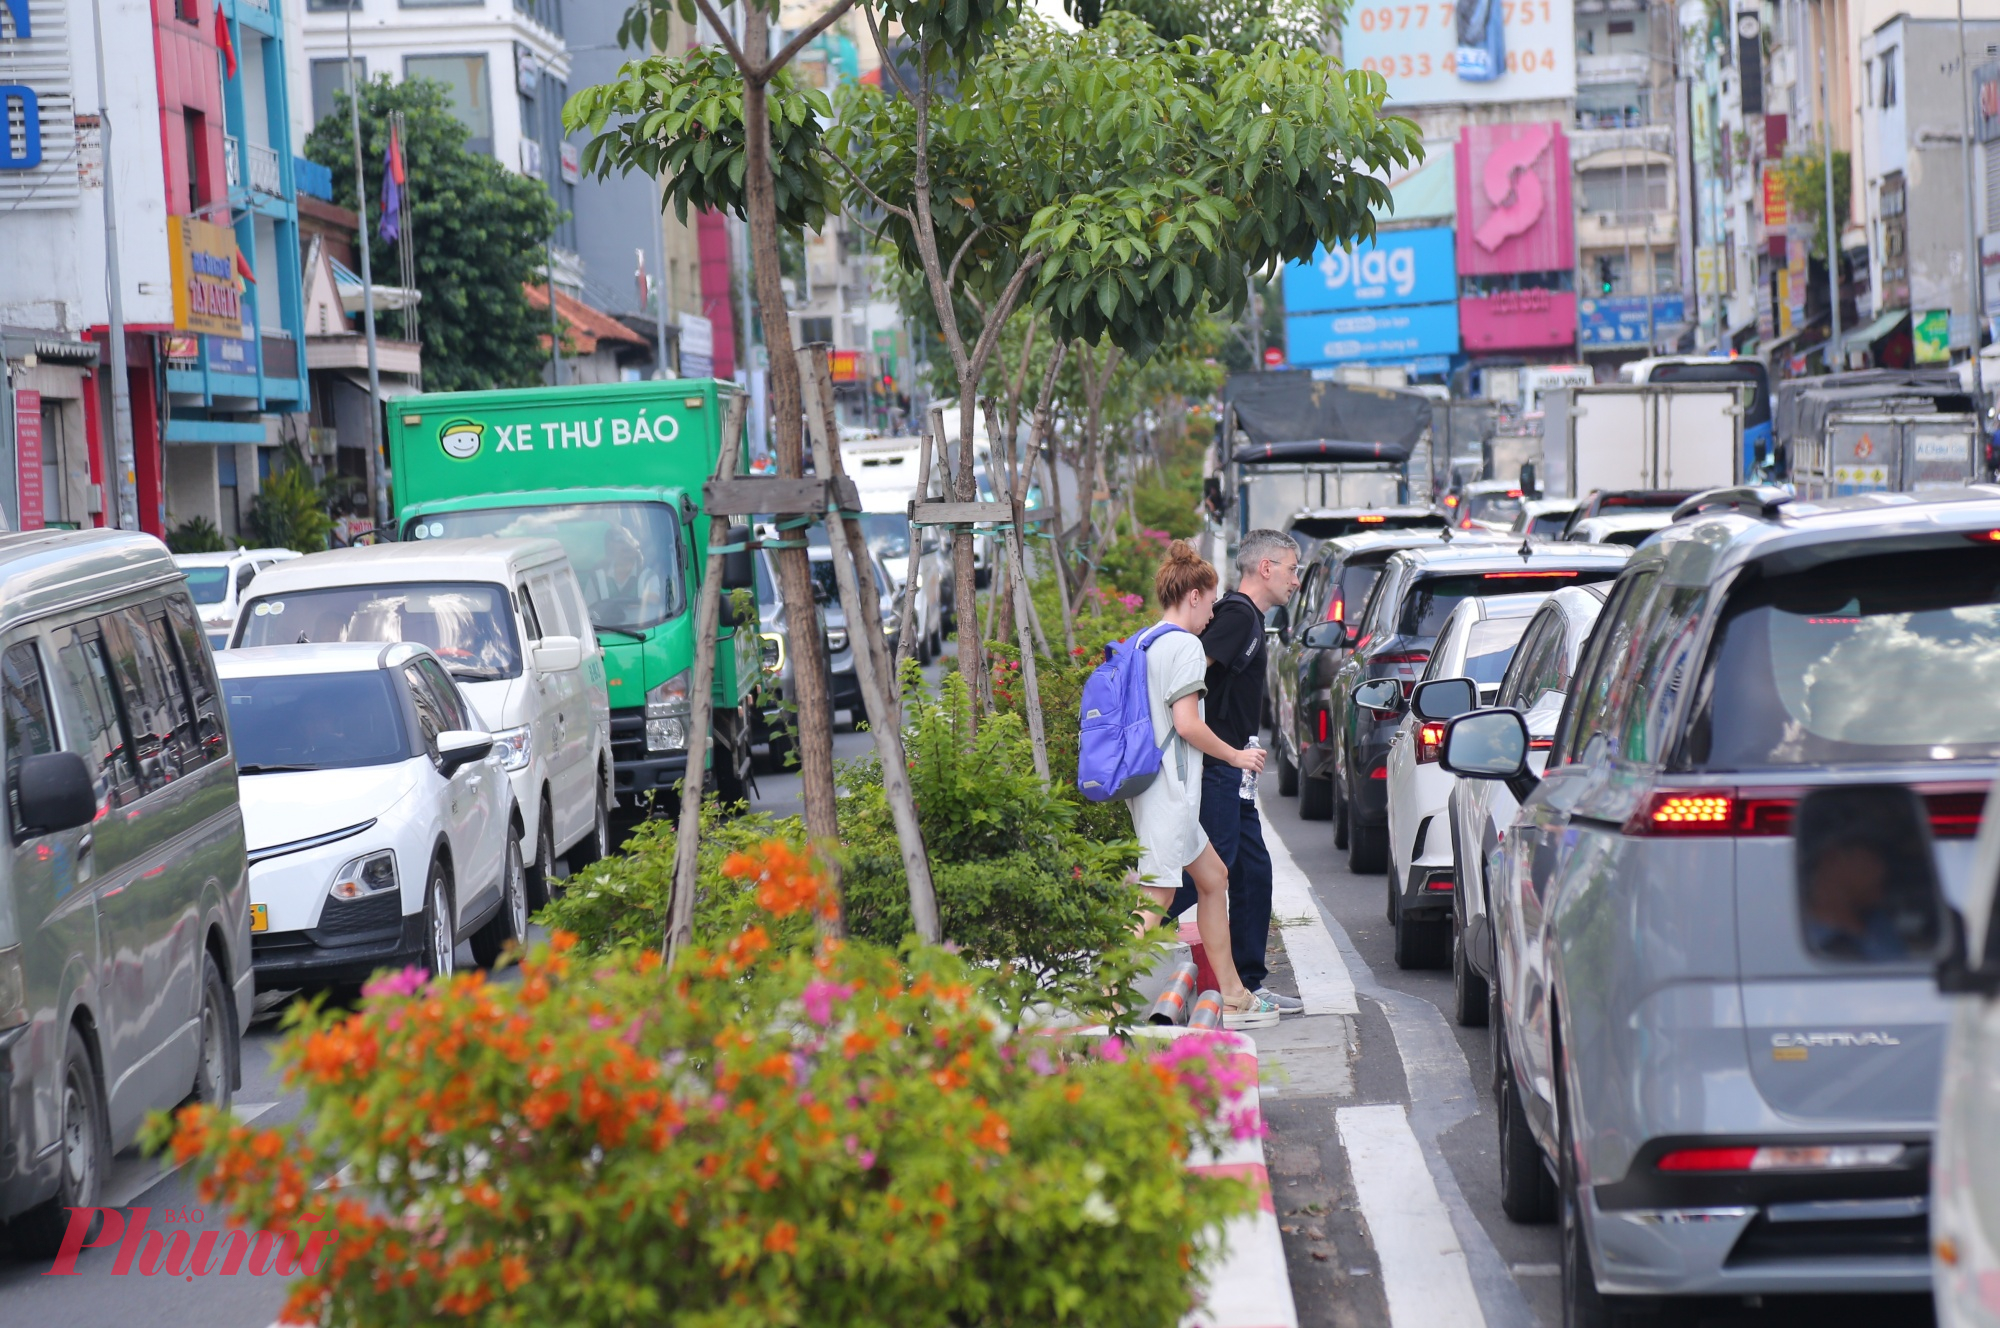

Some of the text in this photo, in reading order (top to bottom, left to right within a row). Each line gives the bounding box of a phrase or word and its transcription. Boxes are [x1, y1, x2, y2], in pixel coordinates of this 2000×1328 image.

[1359, 5, 1429, 32] 0977
[1362, 53, 1432, 79] 0933
[494, 408, 679, 453] XE THƯ BÁO
